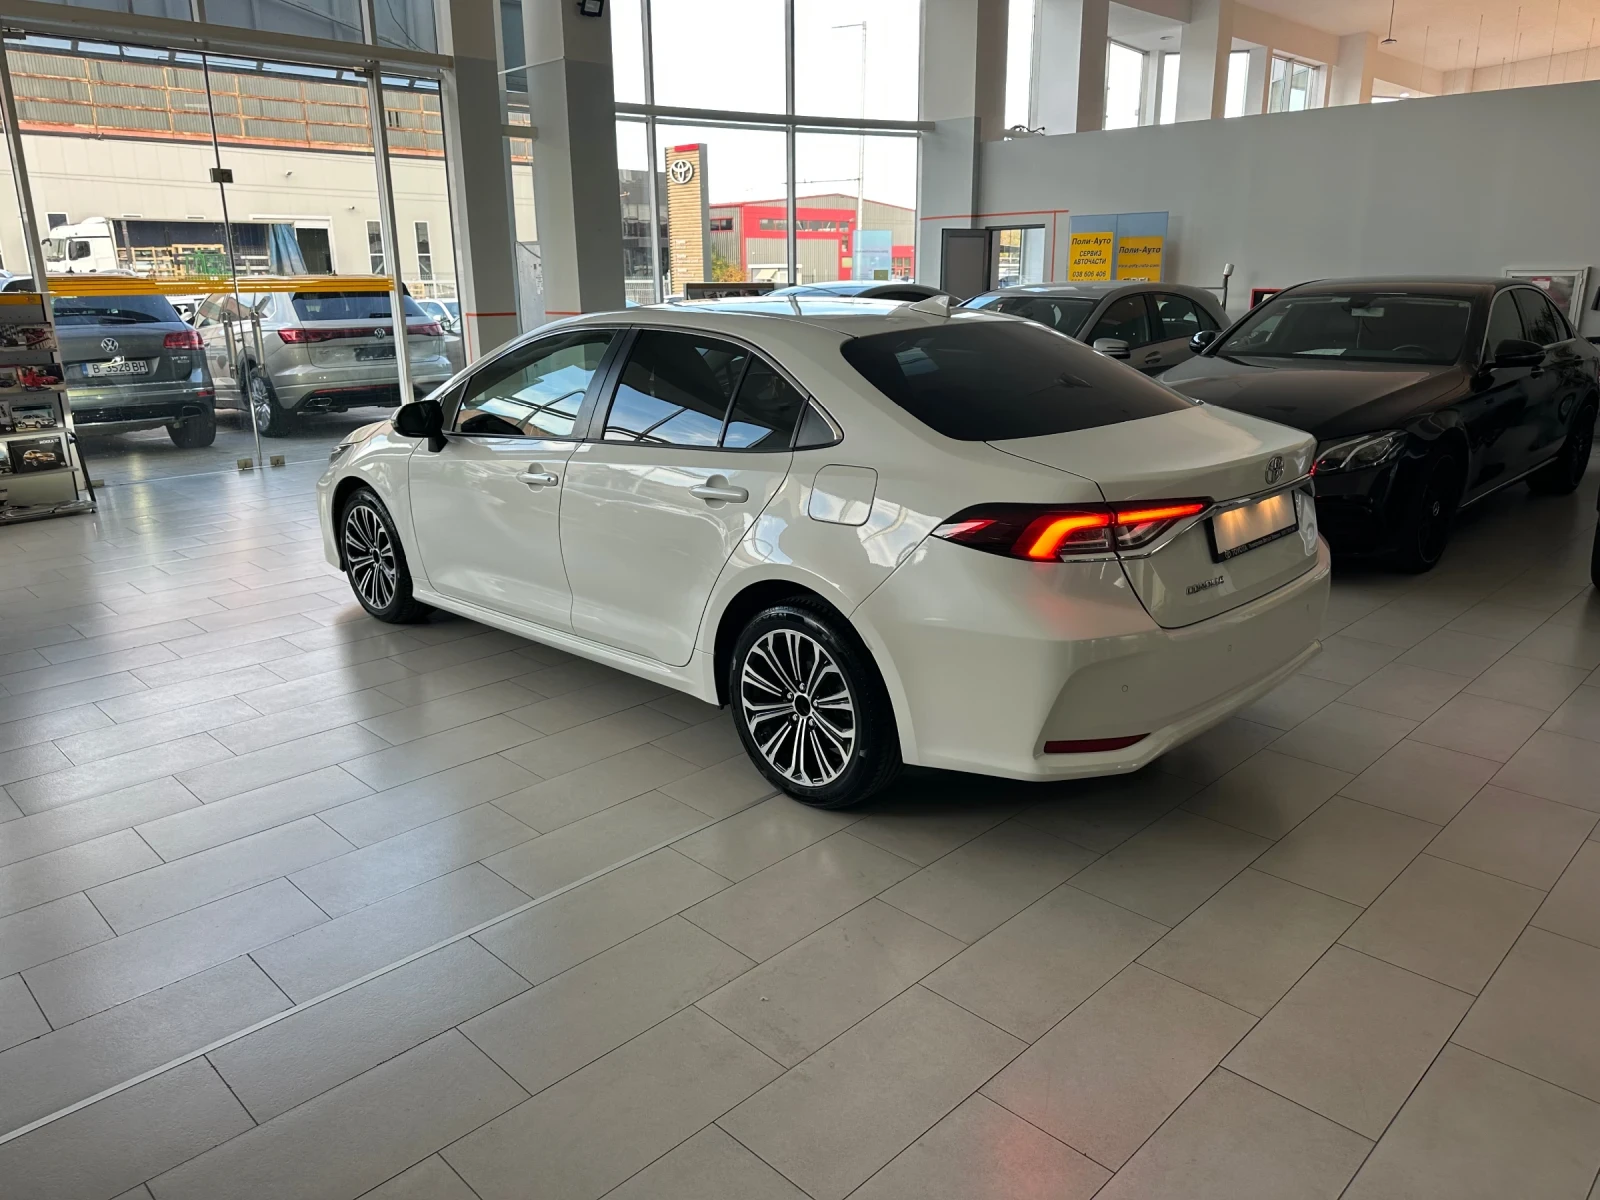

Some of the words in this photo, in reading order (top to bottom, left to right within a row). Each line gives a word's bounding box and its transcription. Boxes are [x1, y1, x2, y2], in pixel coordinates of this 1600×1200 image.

[1072, 237, 1111, 246] Поли-Ауто
[1119, 246, 1161, 255] Поли-Ауто
[131, 361, 147, 371] BH
